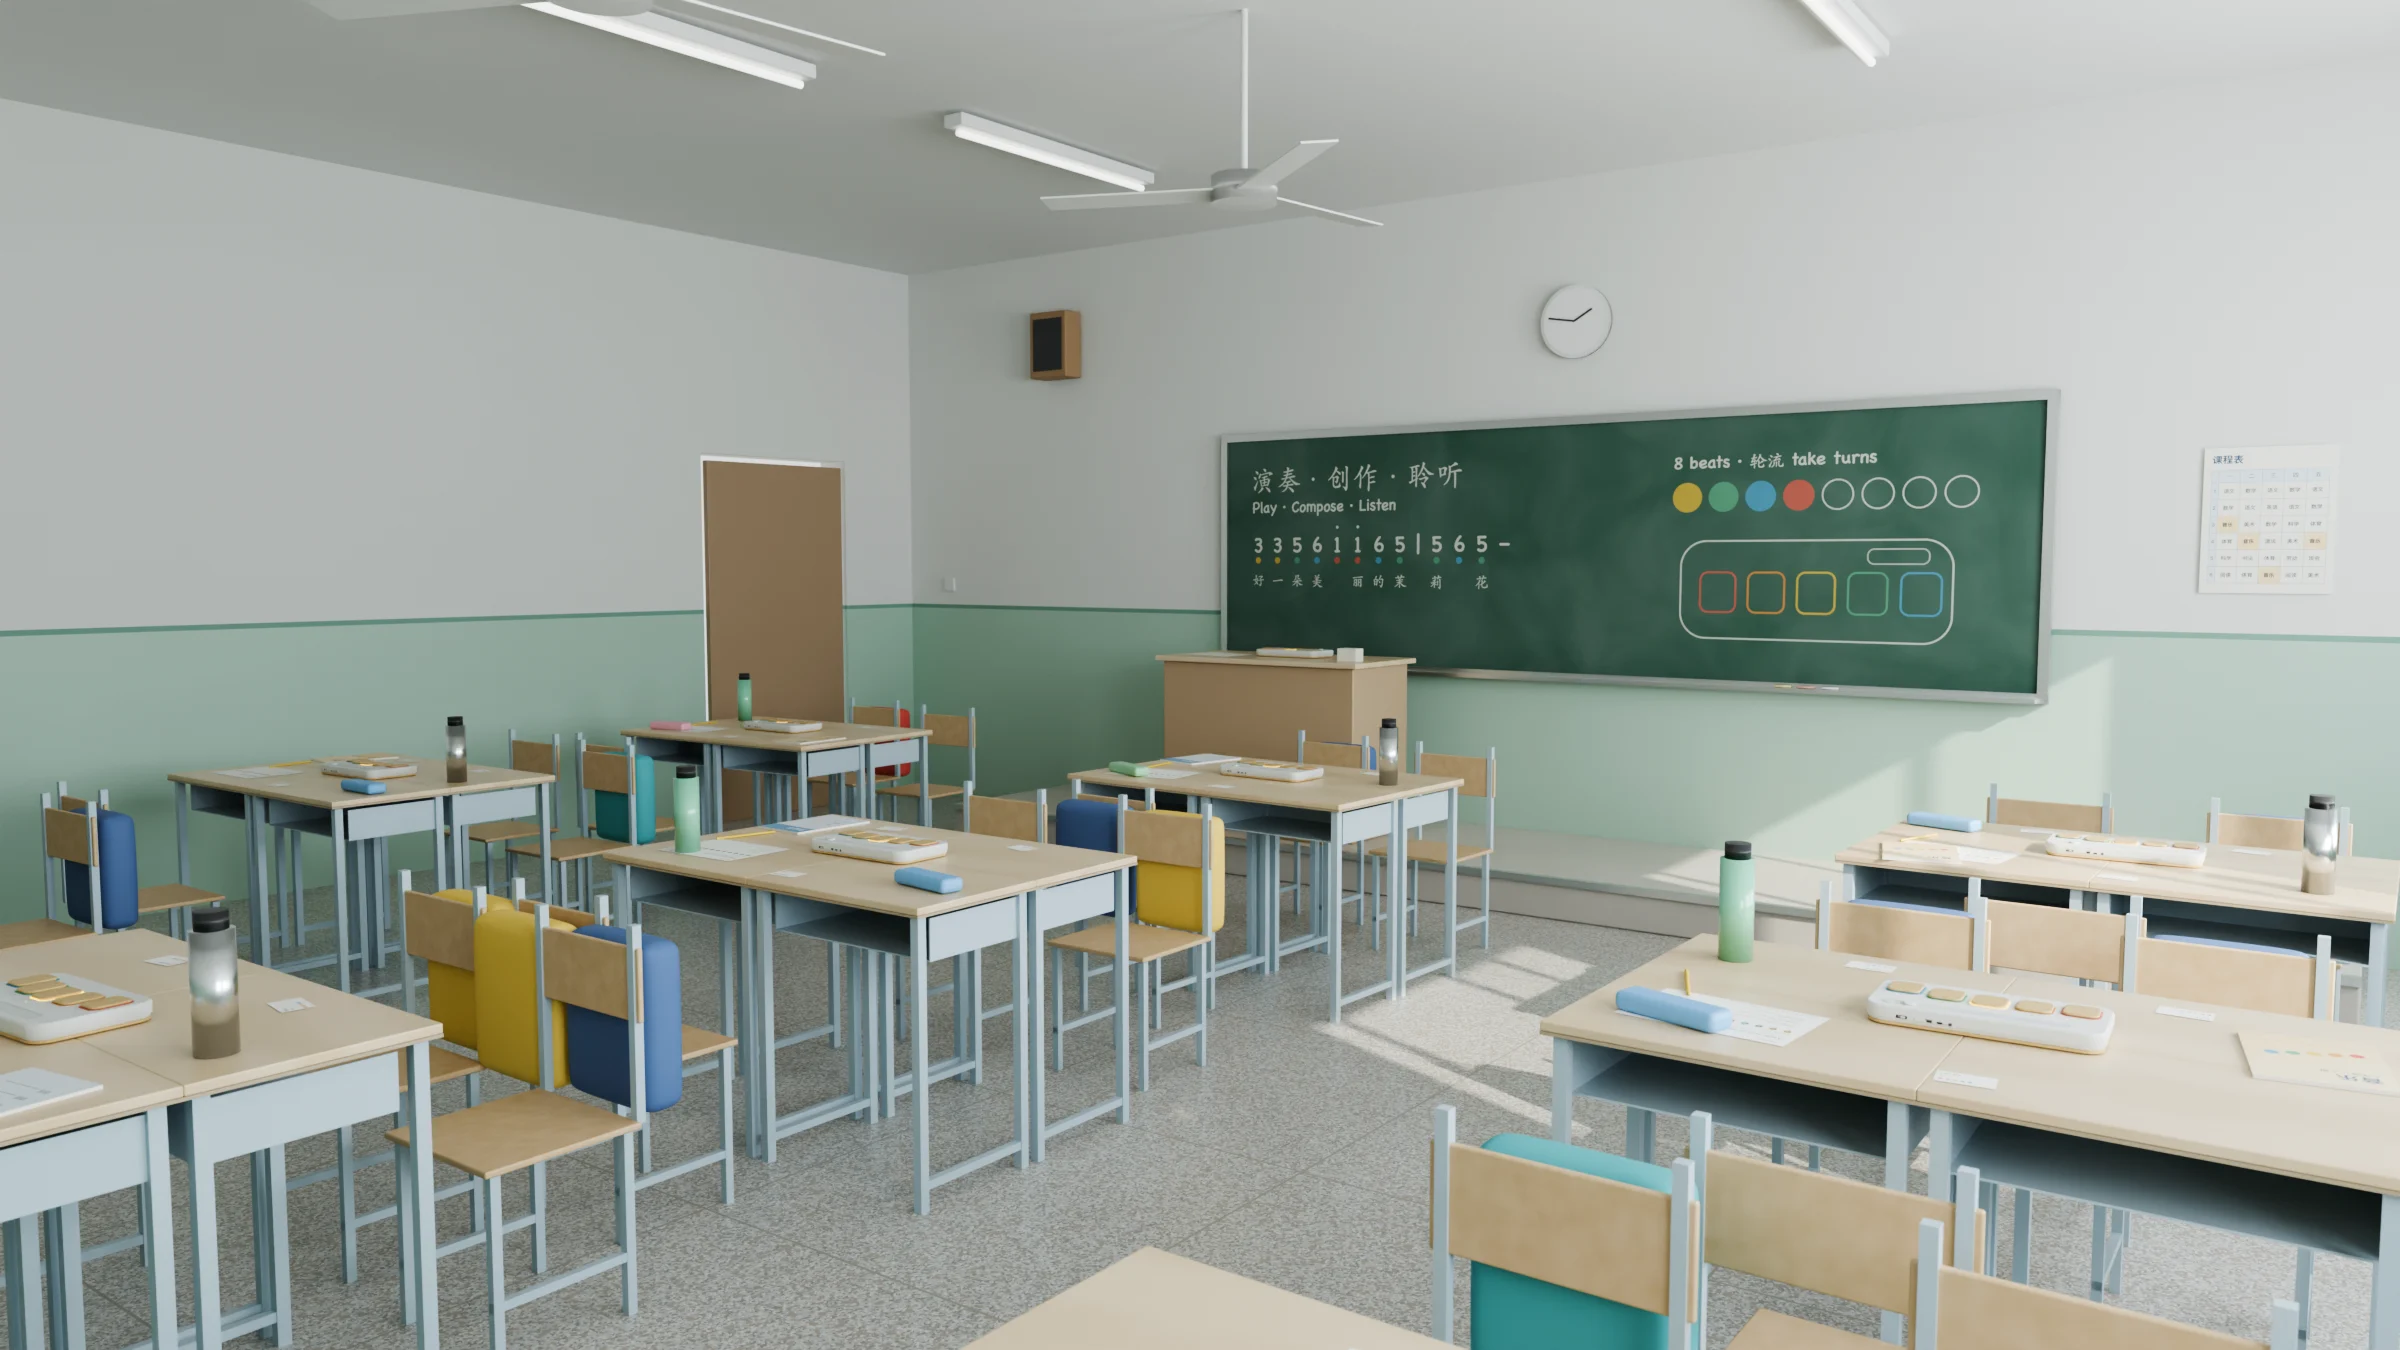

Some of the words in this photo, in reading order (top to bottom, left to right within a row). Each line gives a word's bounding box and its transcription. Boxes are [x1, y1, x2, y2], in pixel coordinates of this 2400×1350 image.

[1673, 457, 1683, 470] 8
[1689, 455, 1730, 469] beats
[1749, 453, 1784, 469] 轮流
[1791, 452, 1826, 466] take
[1833, 451, 1877, 464] turns
[2213, 455, 2243, 464] 课程表
[1253, 467, 1300, 493] 演奏
[1327, 464, 1377, 492] 创作
[1408, 462, 1462, 488] 聆听
[1252, 502, 1277, 516] Play
[1291, 501, 1344, 516] Compose
[1358, 499, 1396, 511] Listen
[1254, 538, 1263, 553] 3
[1273, 537, 1282, 553] 3
[1292, 537, 1302, 553] 5
[1312, 536, 1322, 553] 6
[1373, 536, 1384, 552] 6
[1394, 536, 1405, 553] 5
[1431, 536, 1442, 553] 5
[1453, 535, 1465, 552] 6
[1476, 535, 1487, 552] 5
[1252, 575, 1264, 586] 好
[1291, 575, 1303, 587] 朵
[1311, 574, 1322, 588] 美
[1352, 576, 1363, 587] 丽
[1372, 575, 1384, 588] 的
[1394, 575, 1406, 588] 茉
[1430, 575, 1441, 589] 莉
[1475, 575, 1488, 589] 花
